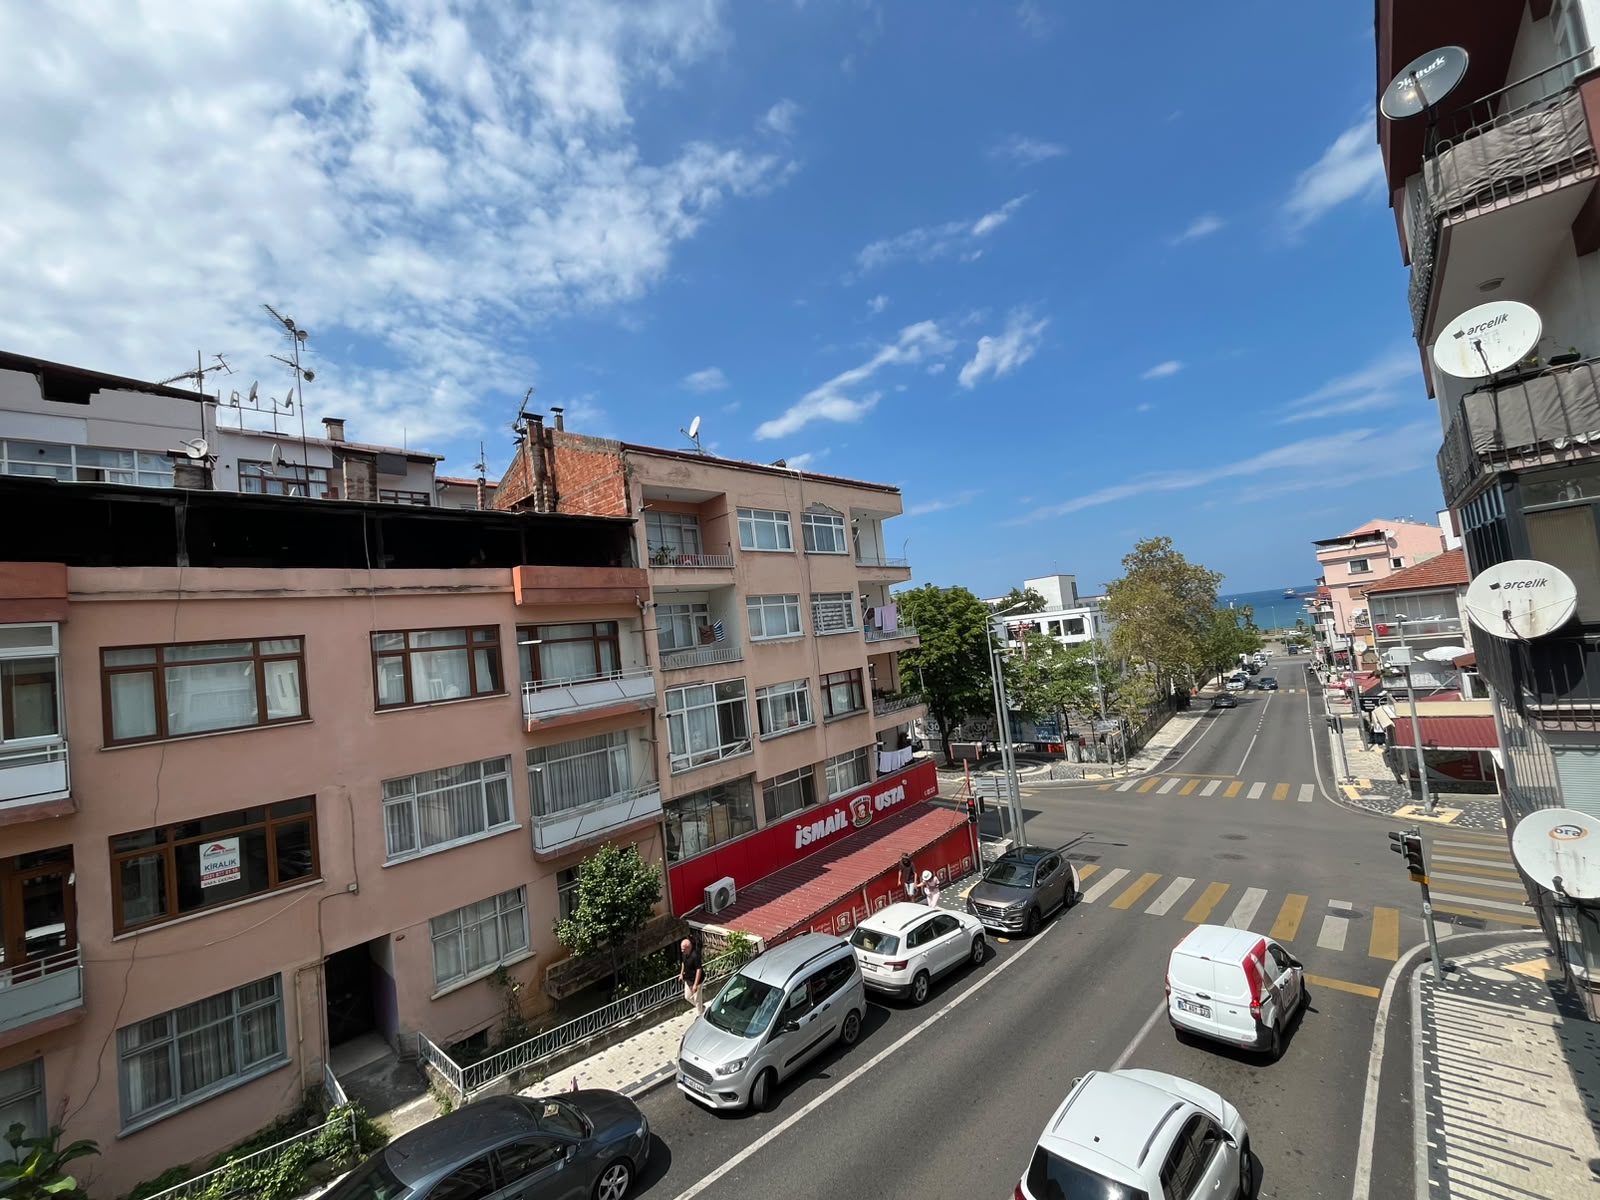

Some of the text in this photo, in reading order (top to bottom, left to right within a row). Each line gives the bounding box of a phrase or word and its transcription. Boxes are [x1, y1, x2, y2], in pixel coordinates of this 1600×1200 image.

[1466, 312, 1509, 336] arçelik
[1503, 578, 1548, 591] arçelik
[795, 785, 905, 849] İSMAİL USTA
